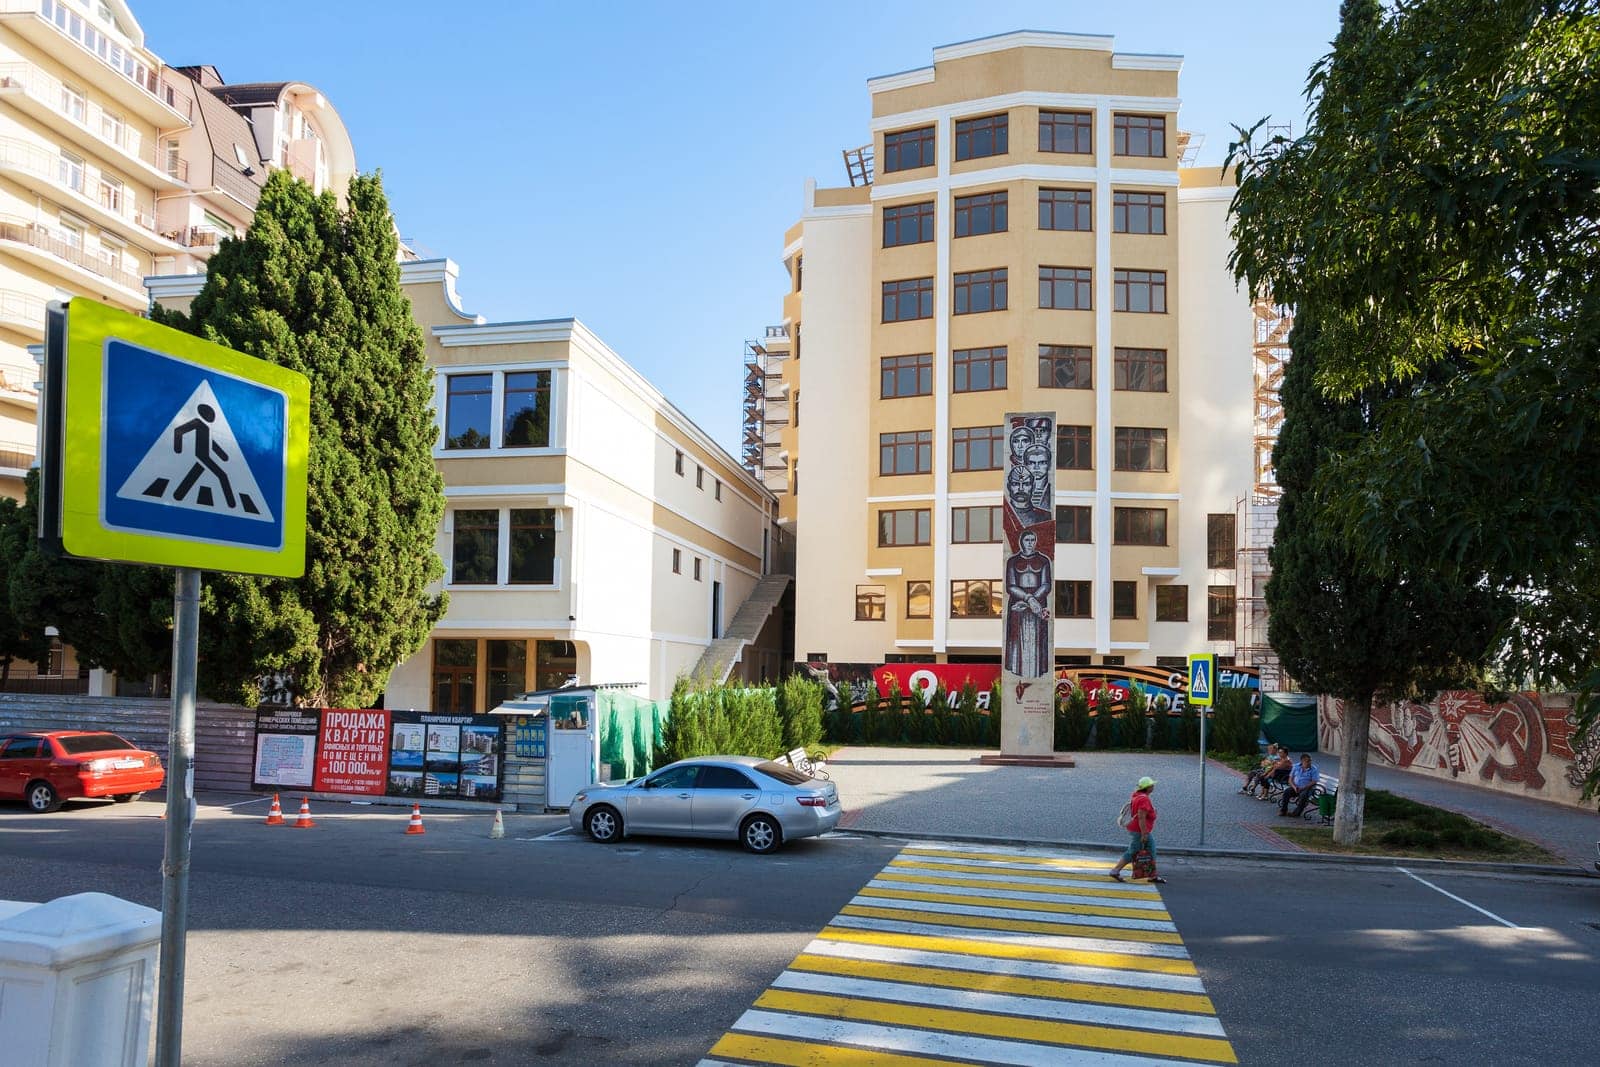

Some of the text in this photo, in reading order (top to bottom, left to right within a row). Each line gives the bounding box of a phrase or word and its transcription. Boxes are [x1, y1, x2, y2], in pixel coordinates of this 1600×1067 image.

[909, 669, 938, 706] 9
[1168, 673, 1182, 688] С
[326, 712, 386, 730] ПРОДАЖА
[325, 729, 385, 745] КВАРТИР,
[324, 743, 350, 751] ОФИСНЫХ
[356, 744, 383, 752] ТОРГОВЫХ
[323, 751, 383, 762] ПОМЕЩЕНИЙ
[329, 761, 345, 773] 100
